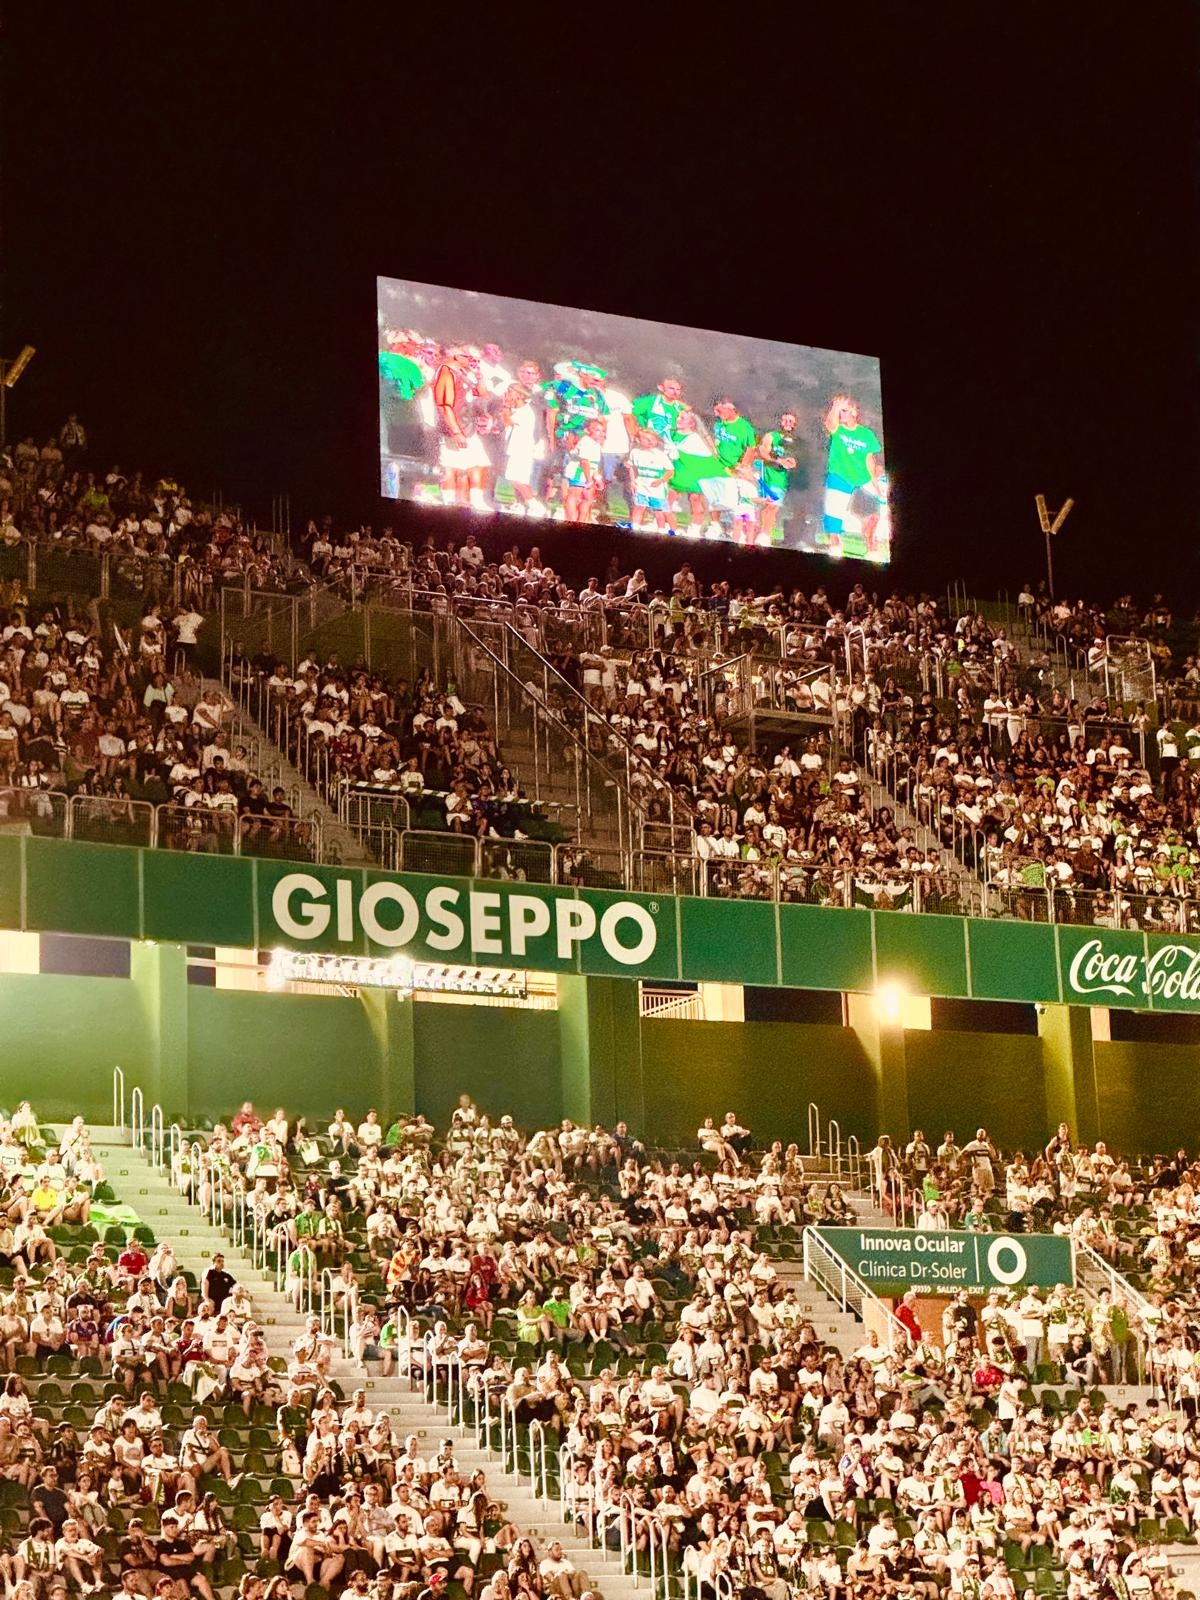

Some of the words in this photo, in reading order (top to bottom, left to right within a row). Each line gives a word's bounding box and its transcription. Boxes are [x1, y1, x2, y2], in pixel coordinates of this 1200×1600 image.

[860, 1233, 912, 1251] Innova
[914, 1235, 966, 1253] Ocular
[858, 1260, 907, 1277] Clínica
[968, 1286, 985, 1294] EXIT
